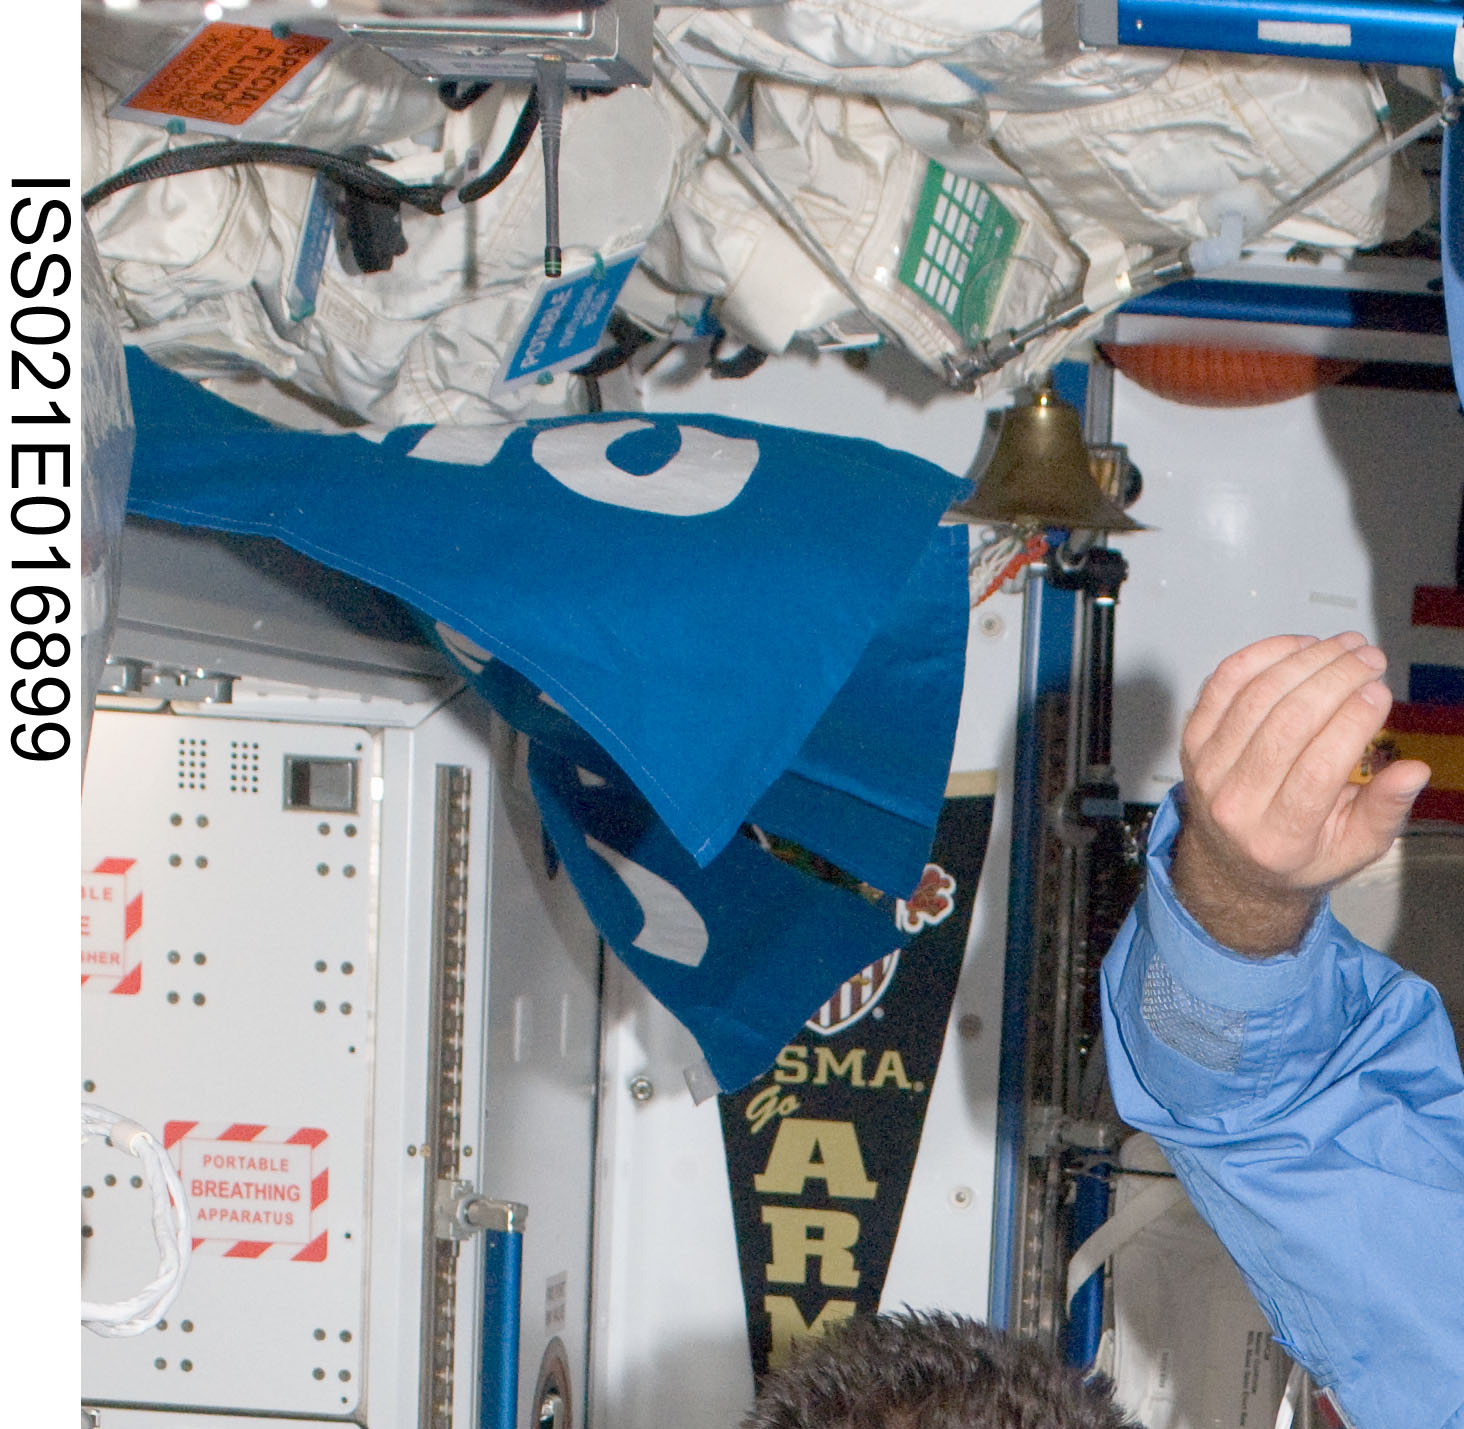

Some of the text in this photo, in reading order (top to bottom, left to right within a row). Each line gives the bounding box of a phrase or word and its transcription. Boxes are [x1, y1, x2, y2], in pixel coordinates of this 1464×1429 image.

[745, 1084, 799, 1134] Go
[203, 1154, 289, 1172] PORTABLE
[191, 1180, 301, 1202] BREATHING
[197, 1208, 295, 1226] APPARATUS
